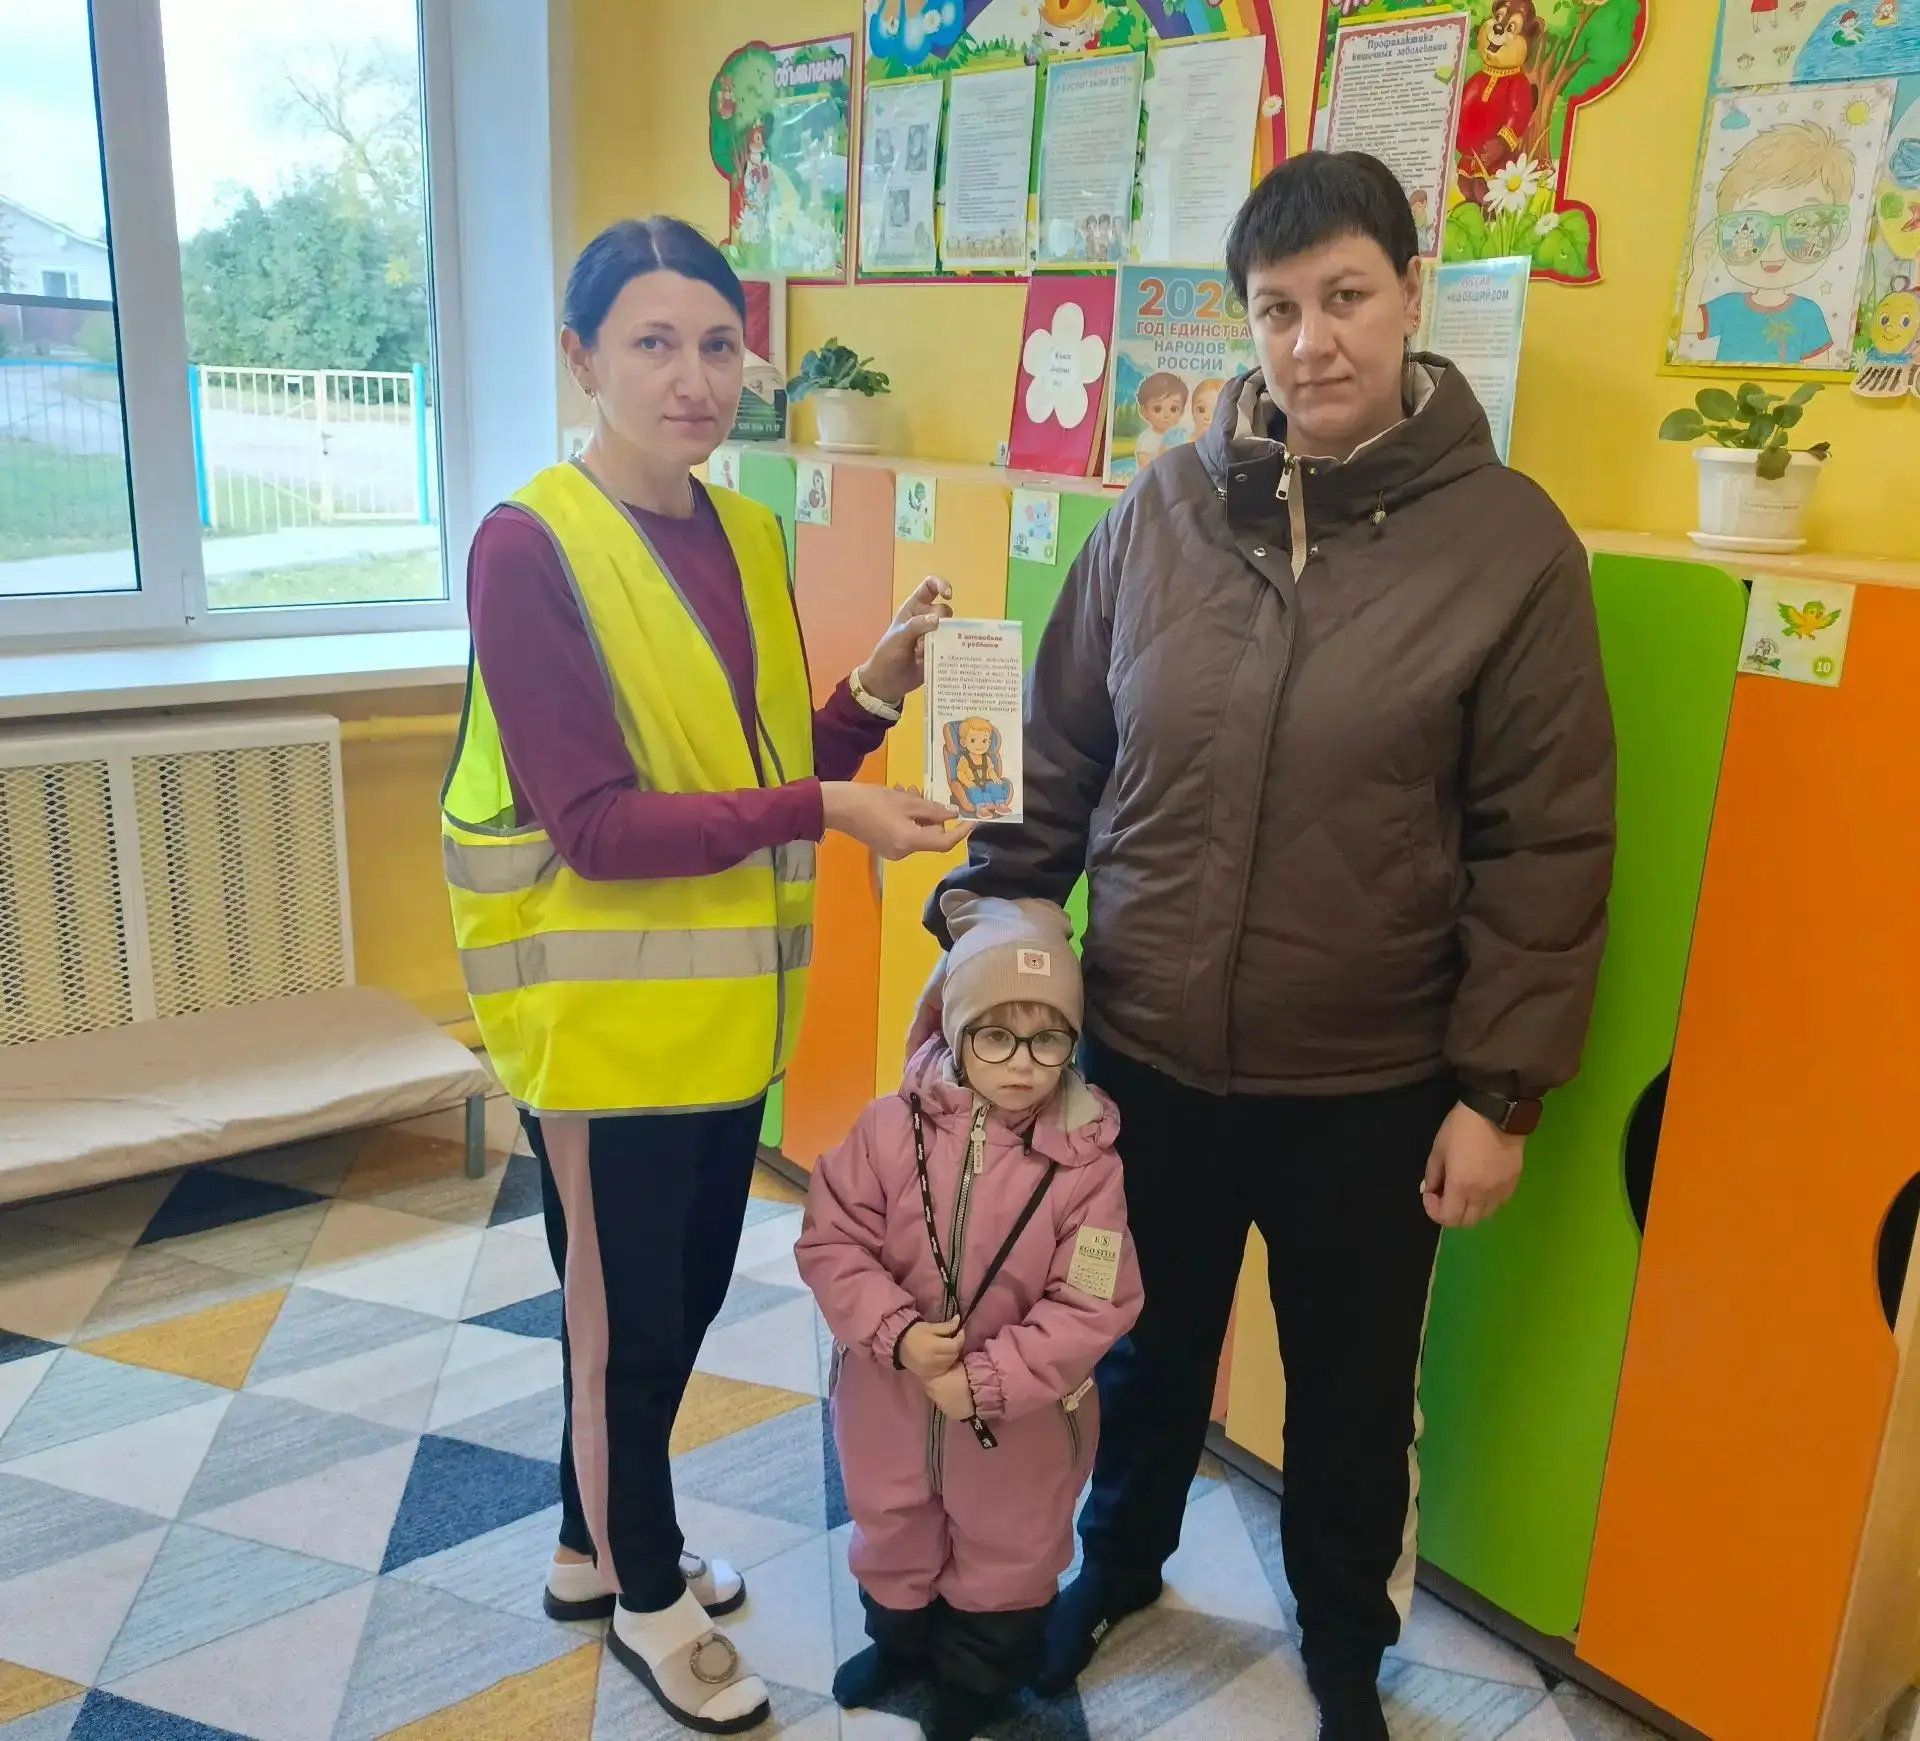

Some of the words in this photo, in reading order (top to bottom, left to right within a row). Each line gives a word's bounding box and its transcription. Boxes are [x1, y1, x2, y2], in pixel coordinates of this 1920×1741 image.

[1367, 33, 1434, 50] Профилактика
[1352, 49, 1392, 61] кишечных
[1396, 42, 1448, 56] заболеваний
[1137, 322, 1165, 337] ГОД
[1170, 323, 1250, 338] ЕДИНСТВА
[1154, 340, 1226, 355] НАРОДОВ
[1158, 357, 1222, 370] РОССИИ
[1815, 661, 1831, 672] 10
[1079, 1245, 1095, 1254] EGO
